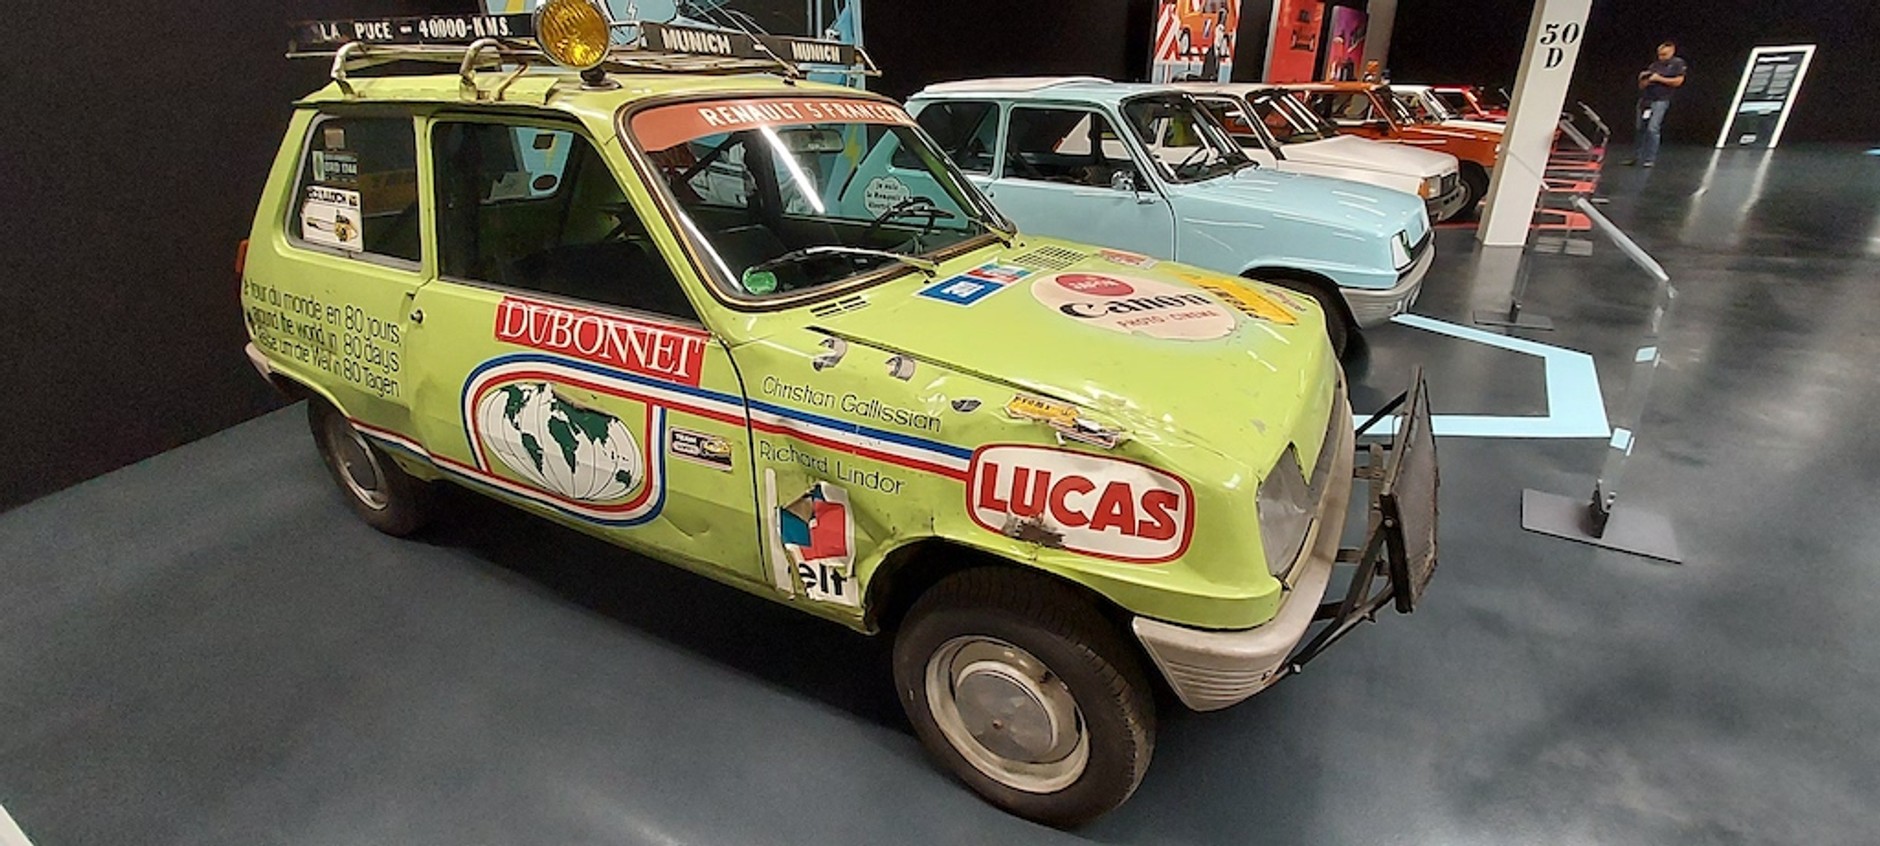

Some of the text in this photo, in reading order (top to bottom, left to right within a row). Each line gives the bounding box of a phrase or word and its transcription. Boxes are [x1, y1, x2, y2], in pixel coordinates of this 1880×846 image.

[320, 22, 341, 41] LA
[354, 20, 393, 40] PUCE
[660, 27, 732, 54] MUNICH
[1540, 22, 1580, 46] 50
[791, 40, 841, 63] MUNICH
[1544, 47, 1563, 69] D
[698, 101, 805, 127] RENAULT
[808, 102, 824, 120] 5
[268, 284, 282, 308] du
[283, 292, 323, 321] monde
[326, 305, 341, 326] en
[345, 304, 364, 334] 80
[364, 316, 401, 347] jours,
[1058, 292, 1213, 319] Canon
[1116, 309, 1220, 328] PHOTO CINEMA
[500, 300, 702, 378] DUBONNET
[343, 332, 362, 360] 80
[363, 336, 400, 375] days
[343, 357, 361, 384] 80
[361, 365, 401, 398] Tagen
[763, 375, 836, 409] Christian
[760, 440, 908, 495] Richard Lindor
[978, 461, 1180, 541] LUCAS
